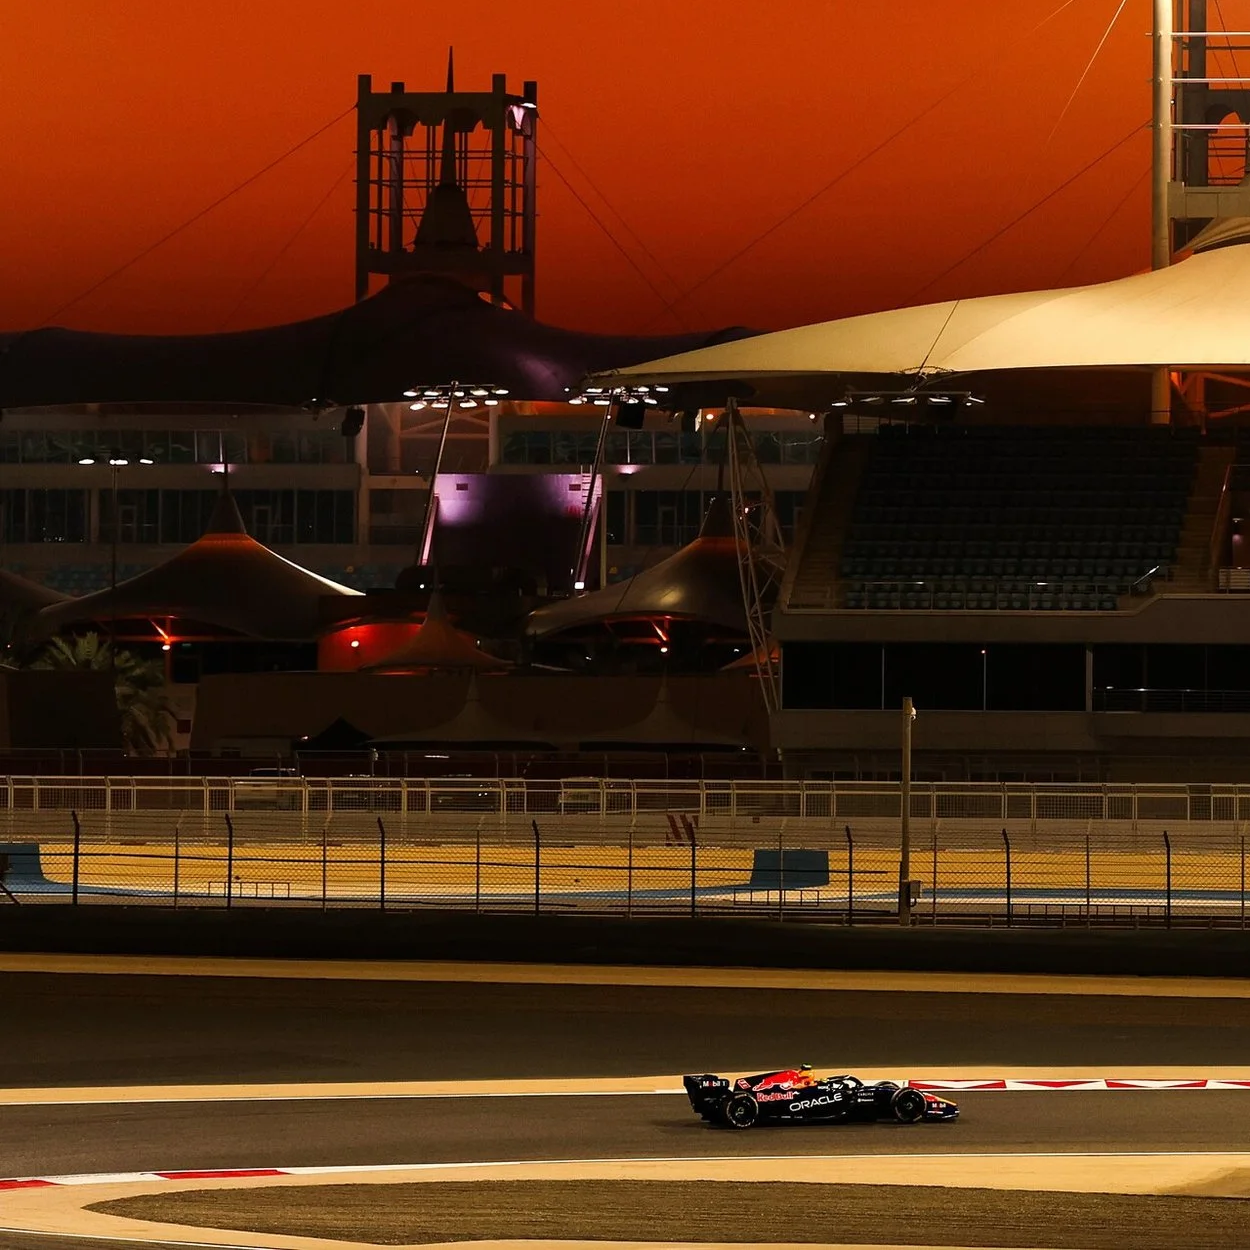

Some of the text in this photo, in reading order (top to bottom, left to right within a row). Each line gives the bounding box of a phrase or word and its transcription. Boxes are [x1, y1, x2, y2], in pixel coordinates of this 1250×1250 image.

[756, 1091, 795, 1102] Red Bull
[789, 1092, 843, 1112] ORACLE
